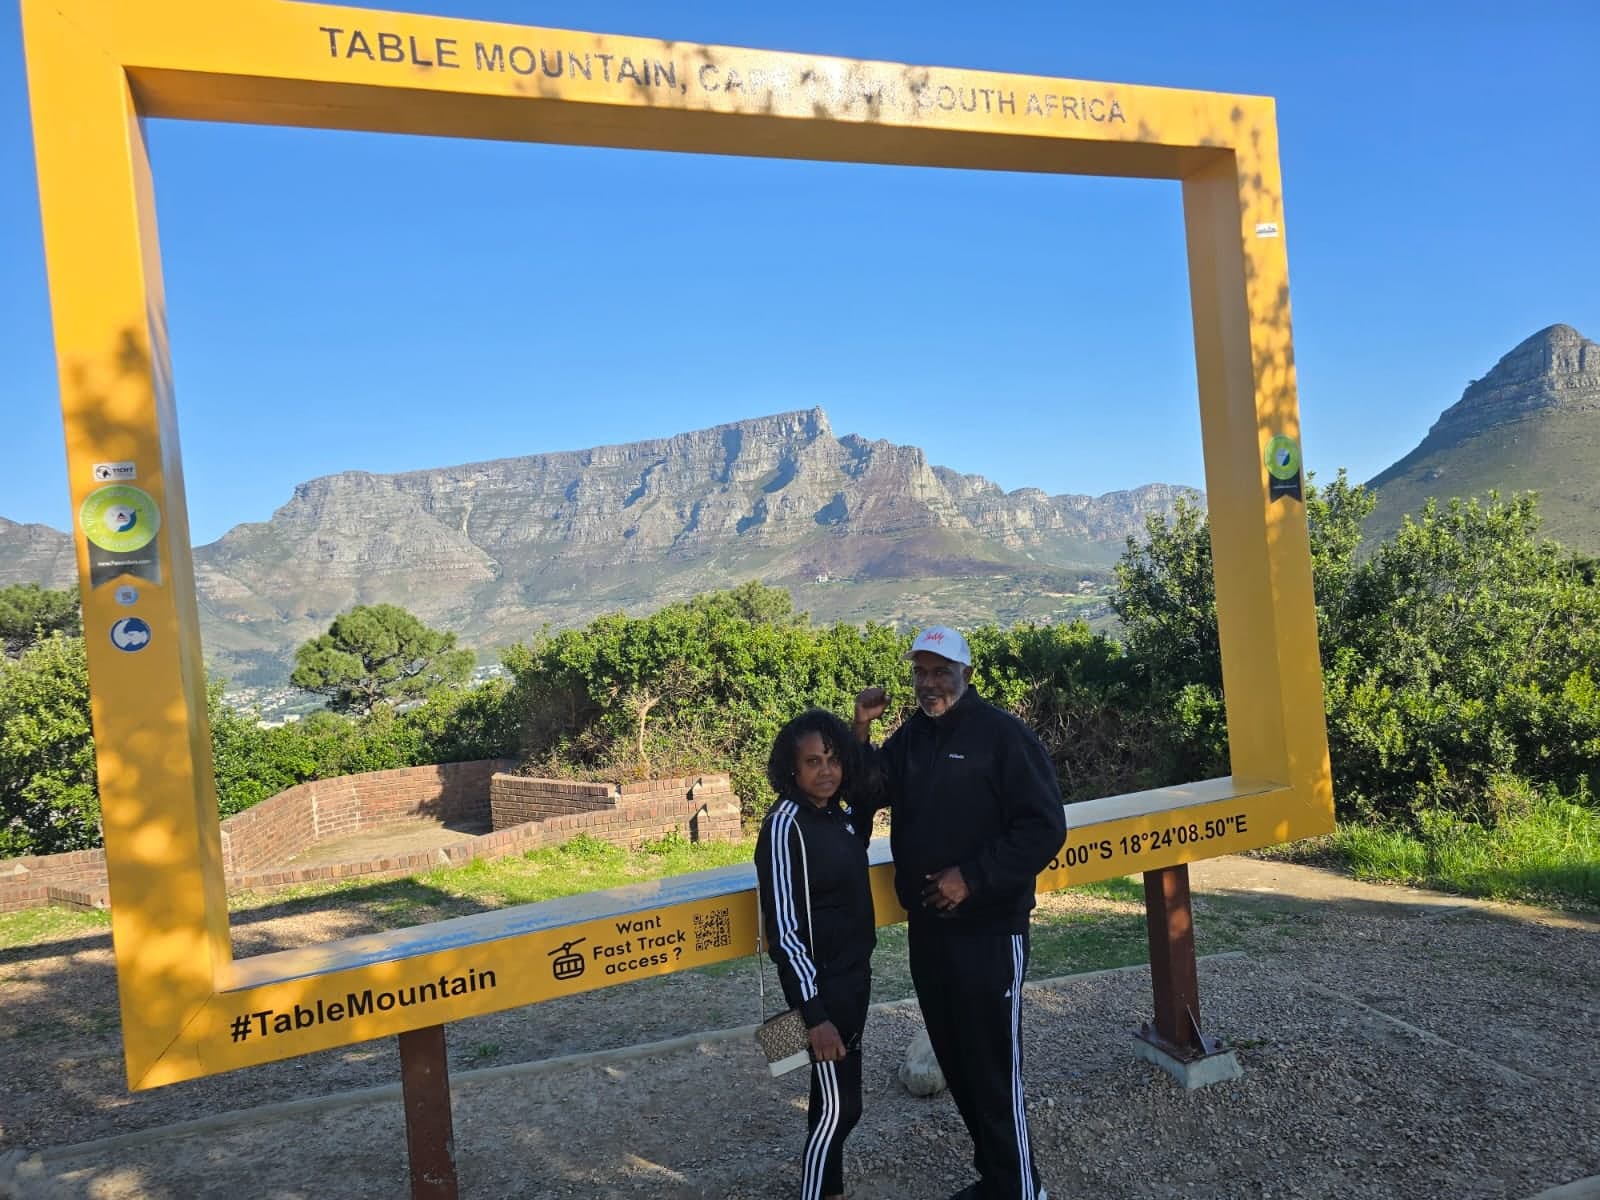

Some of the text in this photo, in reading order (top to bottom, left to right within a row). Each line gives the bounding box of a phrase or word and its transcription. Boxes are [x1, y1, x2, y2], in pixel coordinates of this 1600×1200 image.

[319, 26, 460, 69] TABLE
[474, 41, 687, 95] MOUNTAIN,
[1026, 92, 1126, 123] AFRICA
[1119, 814, 1248, 855] 18°24'08.50"E
[616, 915, 662, 935] Want
[593, 929, 687, 960] Fast Track
[605, 952, 668, 975] access
[230, 967, 497, 1042] #TableMountain
